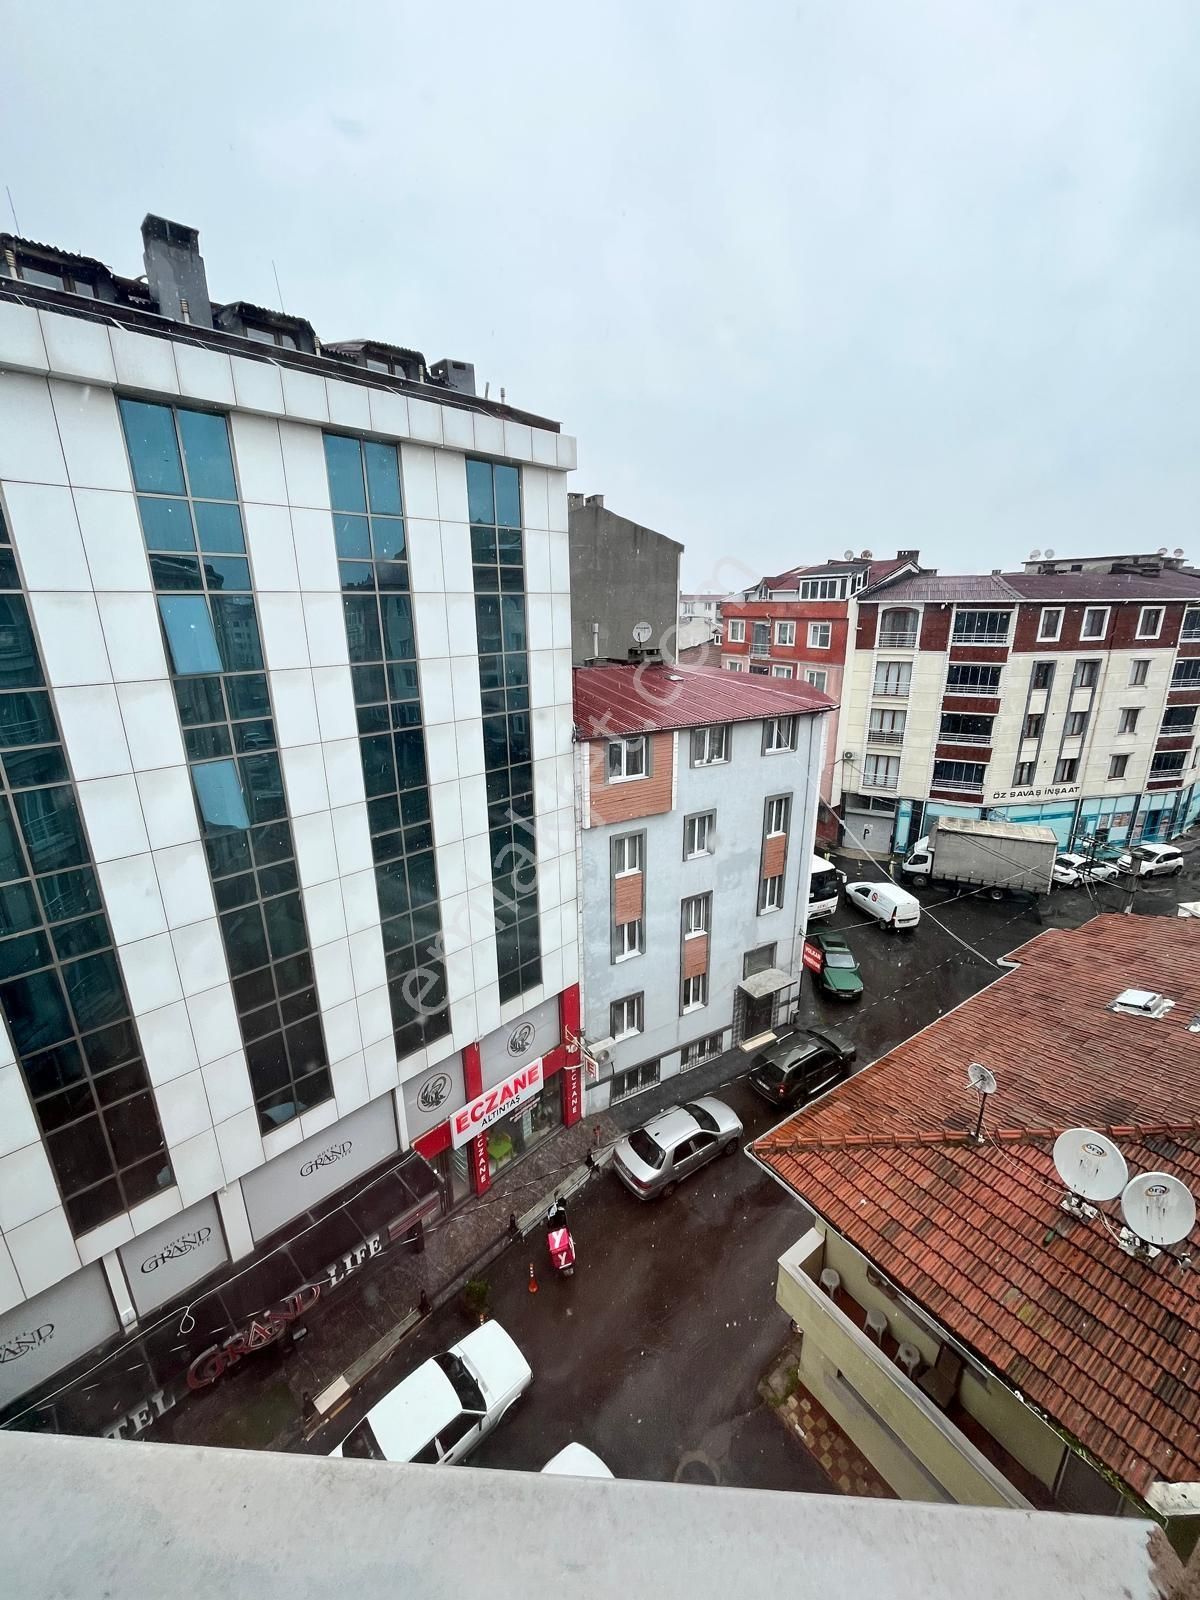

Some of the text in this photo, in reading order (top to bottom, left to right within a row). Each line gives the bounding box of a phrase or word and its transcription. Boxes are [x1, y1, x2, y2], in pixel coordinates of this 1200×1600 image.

[993, 786, 1080, 799] ÖZ SAVAŞ İNŞAAT
[863, 828, 870, 840] P
[455, 1064, 539, 1134] ECZANE
[481, 1095, 520, 1127] ALTINTAŞ
[300, 1141, 352, 1176] GRAND
[141, 1227, 211, 1273] GRAND
[186, 1284, 320, 1389] GRAND
[327, 1234, 383, 1289] LIFE
